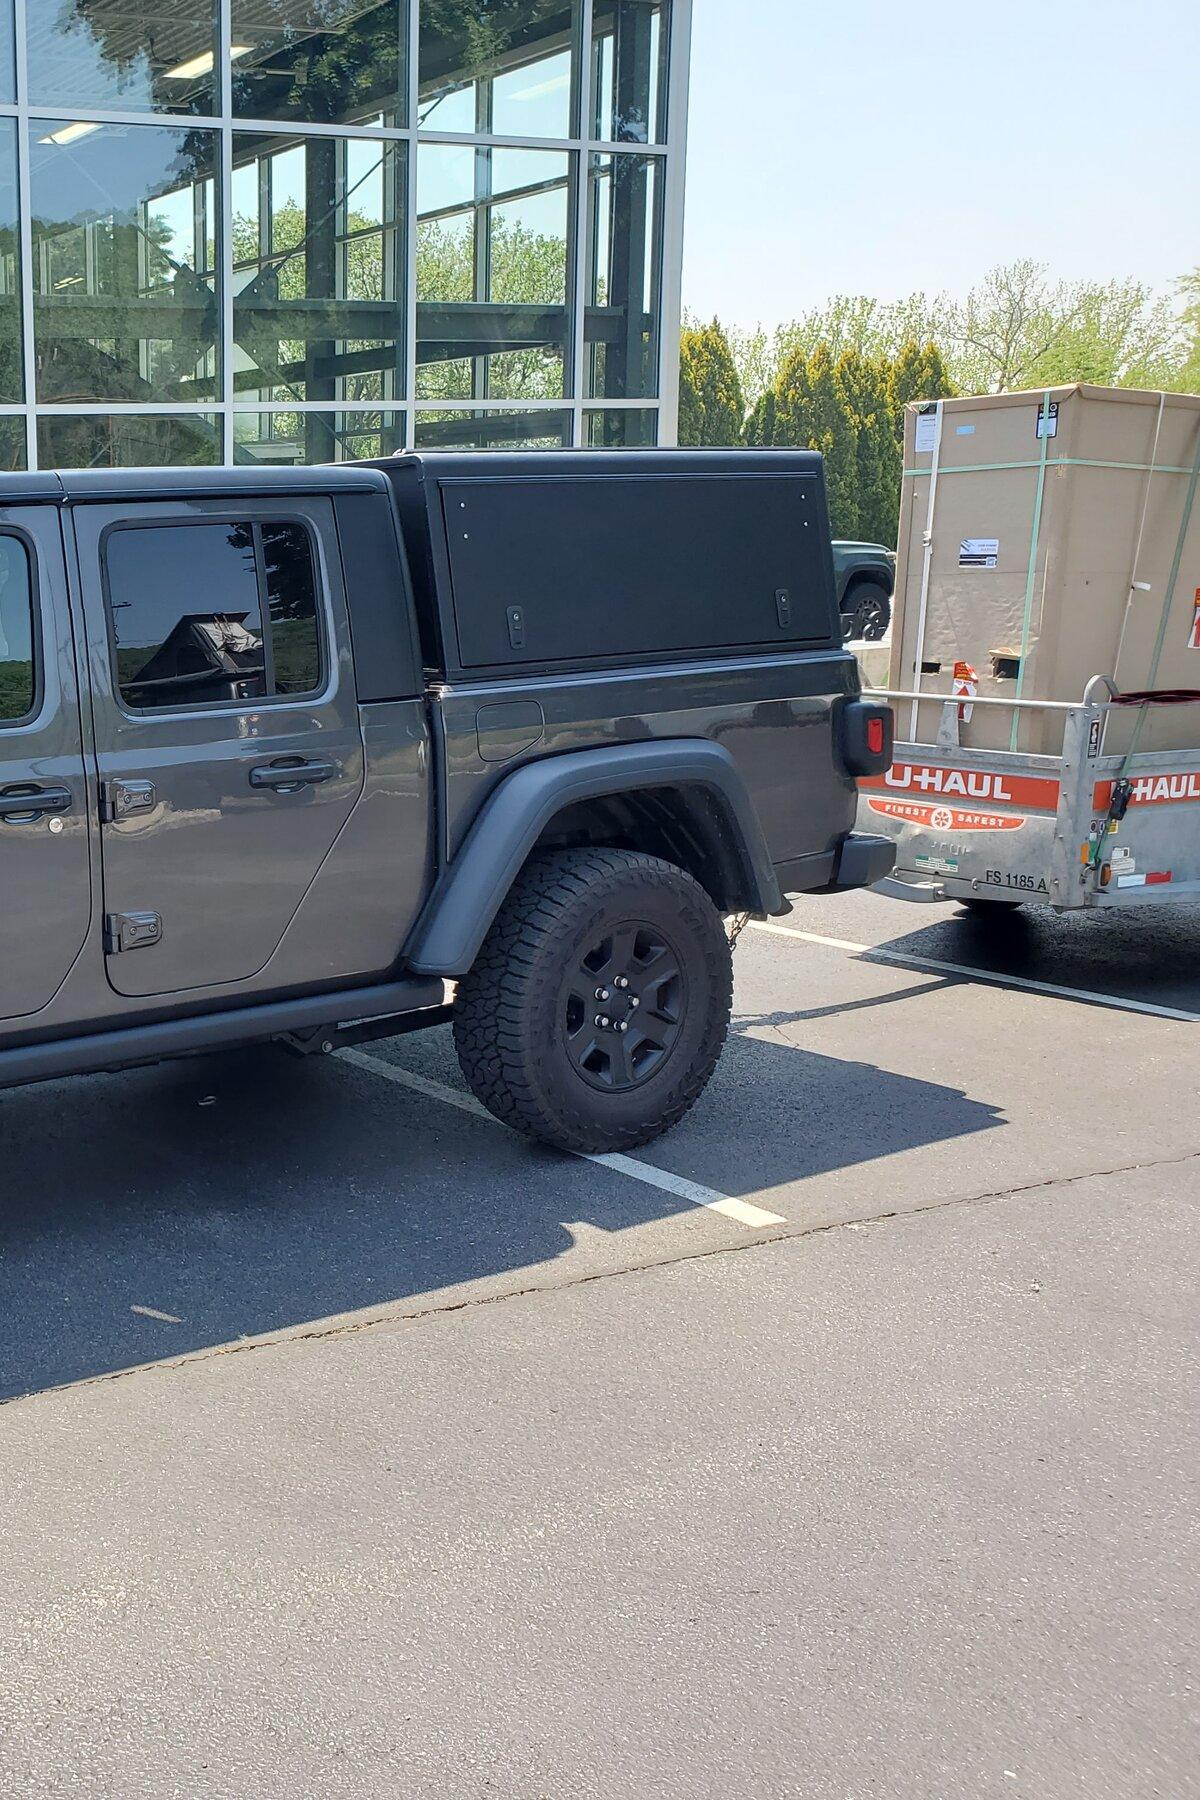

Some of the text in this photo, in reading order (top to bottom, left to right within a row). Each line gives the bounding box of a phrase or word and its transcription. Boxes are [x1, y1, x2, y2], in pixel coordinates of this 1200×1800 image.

[885, 766, 1012, 801] U-HAUL
[1111, 774, 1200, 802] -HAUL
[884, 804, 1005, 827] FINEST SAFEST
[986, 870, 1047, 891] FS 1185 A
